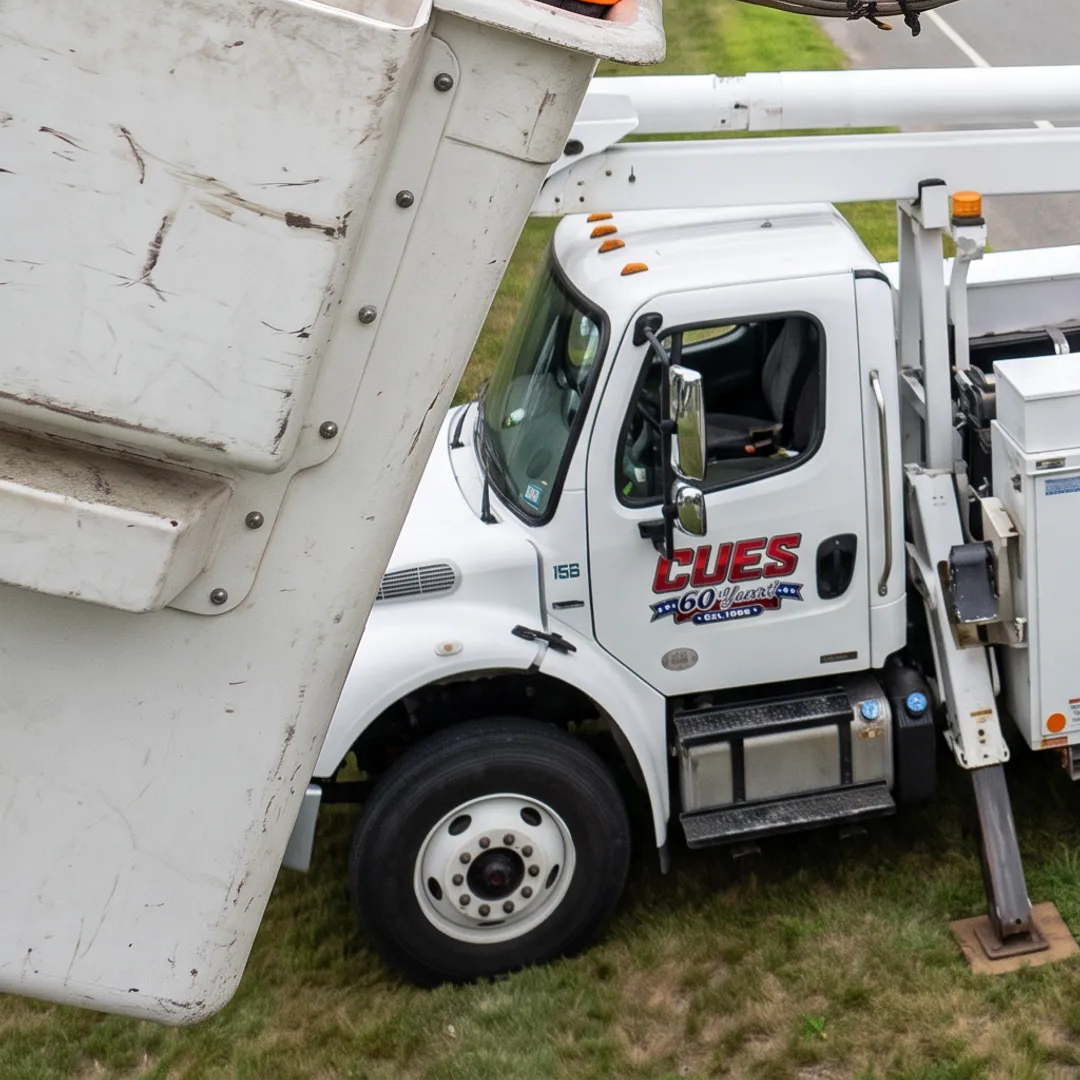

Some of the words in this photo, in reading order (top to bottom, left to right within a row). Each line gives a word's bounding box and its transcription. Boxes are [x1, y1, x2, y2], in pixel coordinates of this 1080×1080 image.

[552, 563, 580, 580] 156
[652, 532, 802, 594] CUES
[678, 587, 716, 614] 60
